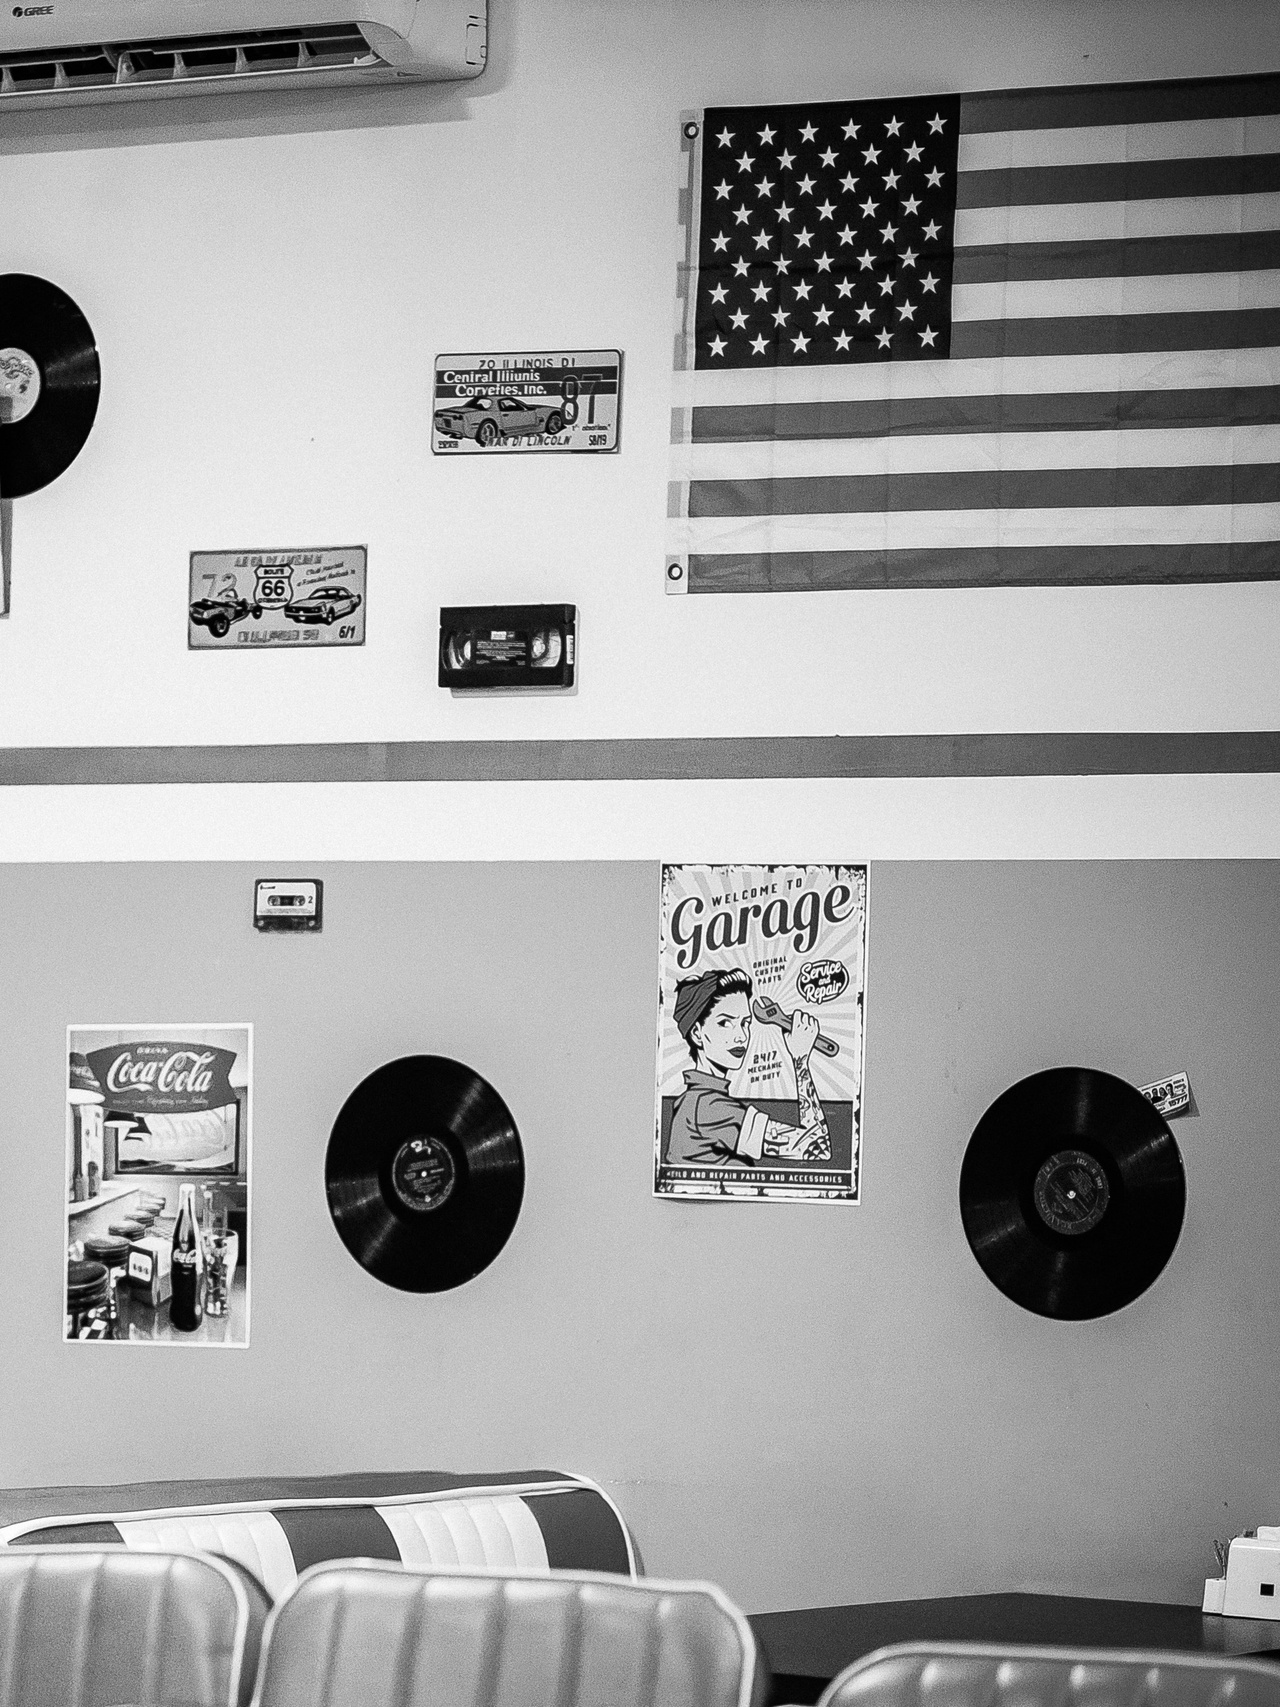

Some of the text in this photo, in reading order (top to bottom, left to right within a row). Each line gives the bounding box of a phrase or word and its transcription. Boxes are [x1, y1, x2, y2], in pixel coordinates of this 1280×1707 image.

[261, 579, 285, 597] 66
[711, 877, 803, 907] WELCOME TO
[307, 895, 314, 904] 2
[671, 884, 855, 969] Garage
[752, 955, 788, 969] ORIGINAL
[754, 964, 786, 977] CUSTOM
[801, 961, 842, 984] Service
[757, 974, 782, 986] PARTS
[818, 974, 831, 986] and
[803, 980, 842, 1005] Repair
[753, 1050, 777, 1065] 24/7
[106, 1051, 218, 1094] Coca-Cola
[747, 1061, 783, 1075] MECHANIC
[750, 1070, 781, 1084] ON DUTY
[690, 1170, 706, 1179] AND
[709, 1171, 737, 1180] REPAIR
[740, 1172, 766, 1181] PARTS
[769, 1173, 785, 1182] AND
[789, 1174, 843, 1184] ACCESSORIES
